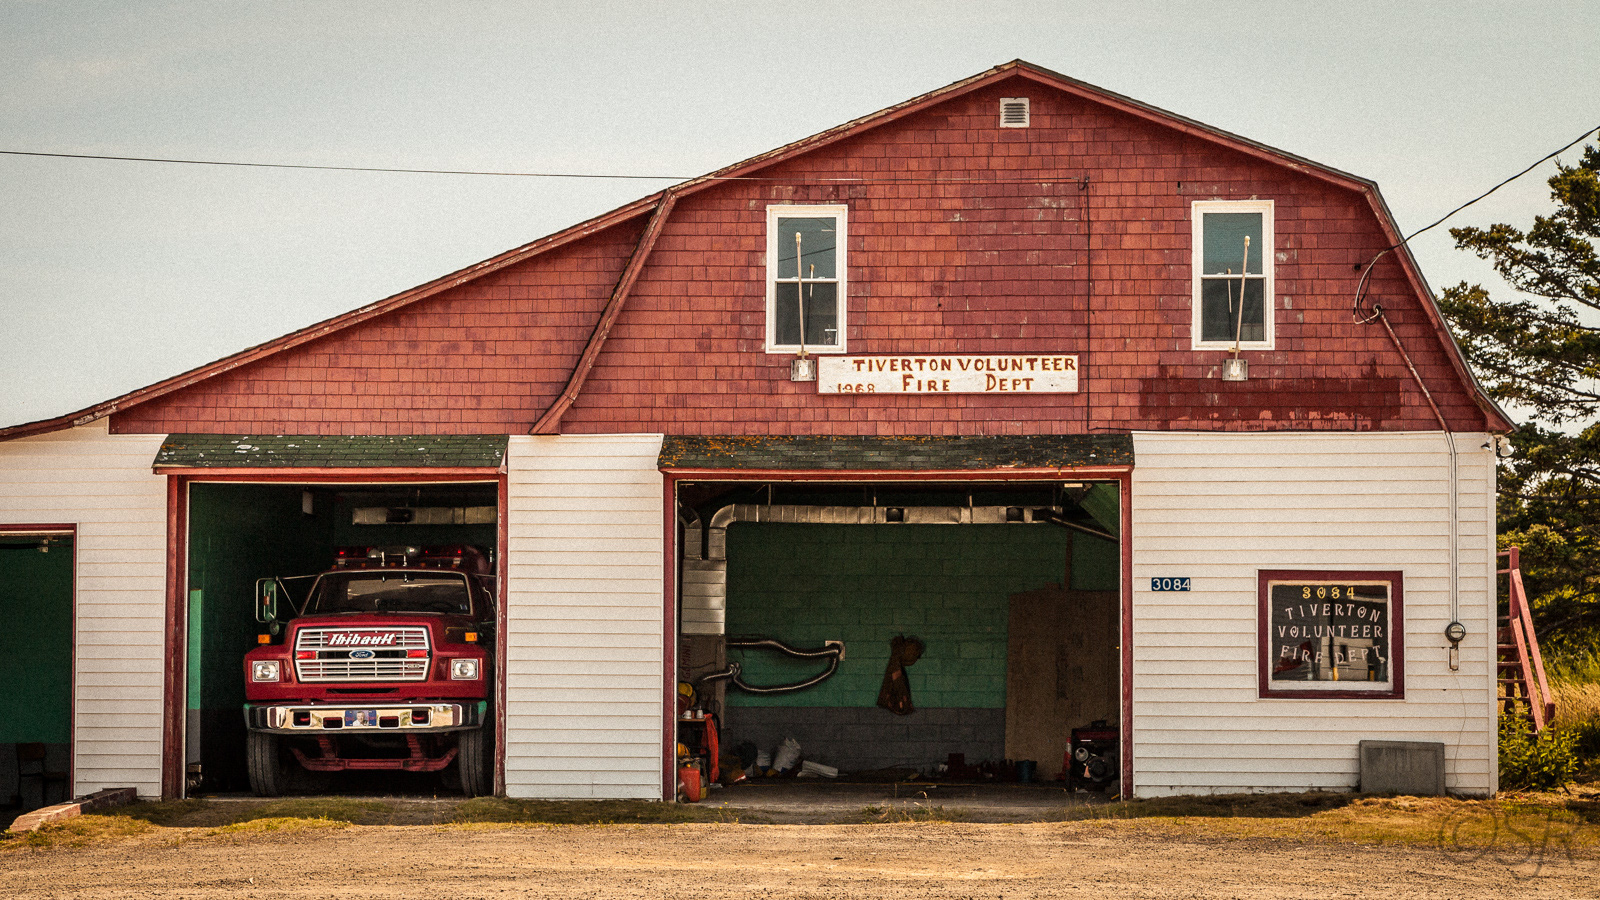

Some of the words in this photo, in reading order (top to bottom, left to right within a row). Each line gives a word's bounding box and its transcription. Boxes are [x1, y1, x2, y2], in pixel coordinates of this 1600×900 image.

[853, 358, 951, 372] TIVERTON
[957, 357, 1076, 372] VOLUNTEER
[837, 383, 875, 393] 1968
[902, 373, 950, 392] FIRE
[985, 373, 1034, 391] DEPT
[1152, 578, 1191, 591] 3084
[1302, 586, 1355, 600] 3084
[1285, 603, 1381, 623] TIVERTON
[1278, 625, 1383, 638] VOLUNTEER
[329, 633, 396, 645] Thibault
[1280, 645, 1323, 663] FIRE
[1334, 645, 1381, 664] DEPT
